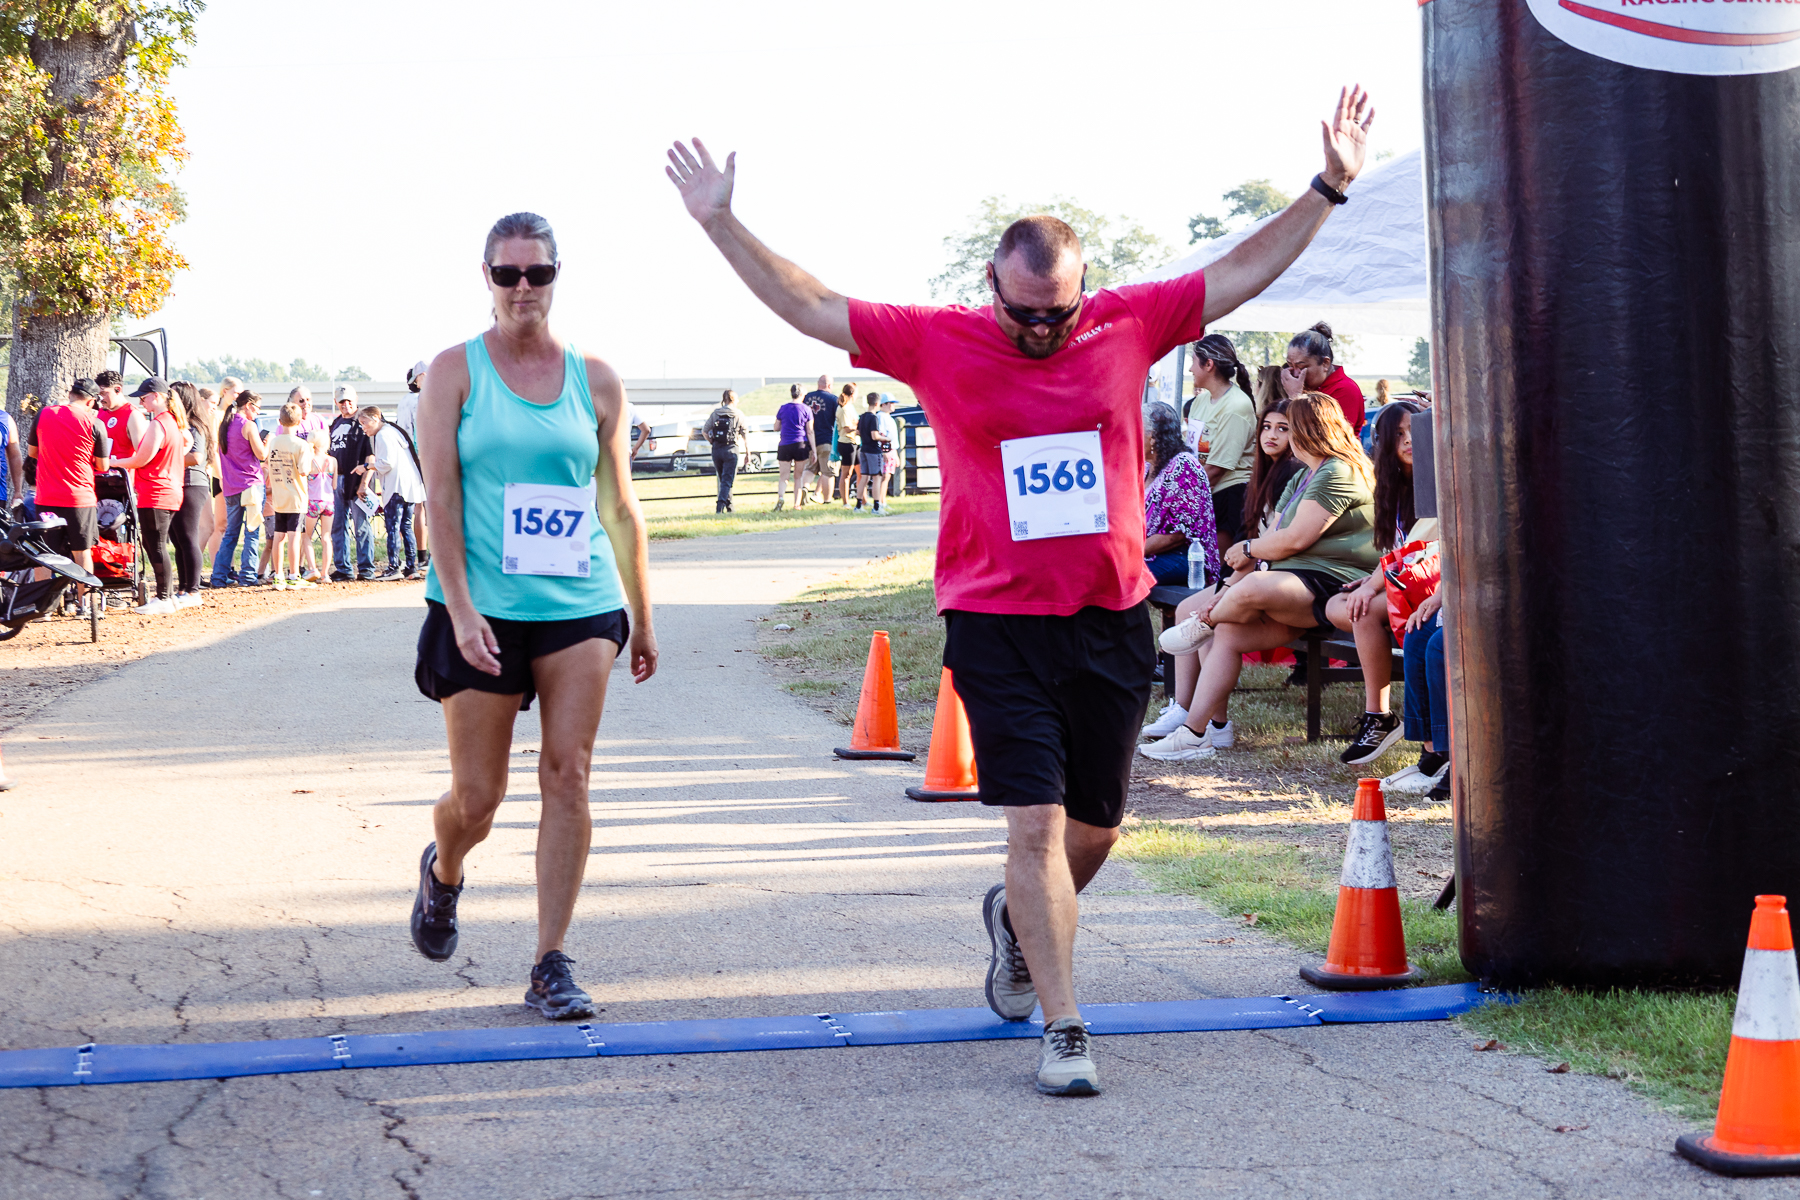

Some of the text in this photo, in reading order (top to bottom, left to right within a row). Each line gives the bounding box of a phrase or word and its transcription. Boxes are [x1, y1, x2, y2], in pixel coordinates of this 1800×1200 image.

[1075, 325, 1102, 343] TULLY
[1013, 458, 1096, 496] 1568
[512, 507, 585, 537] 1567
